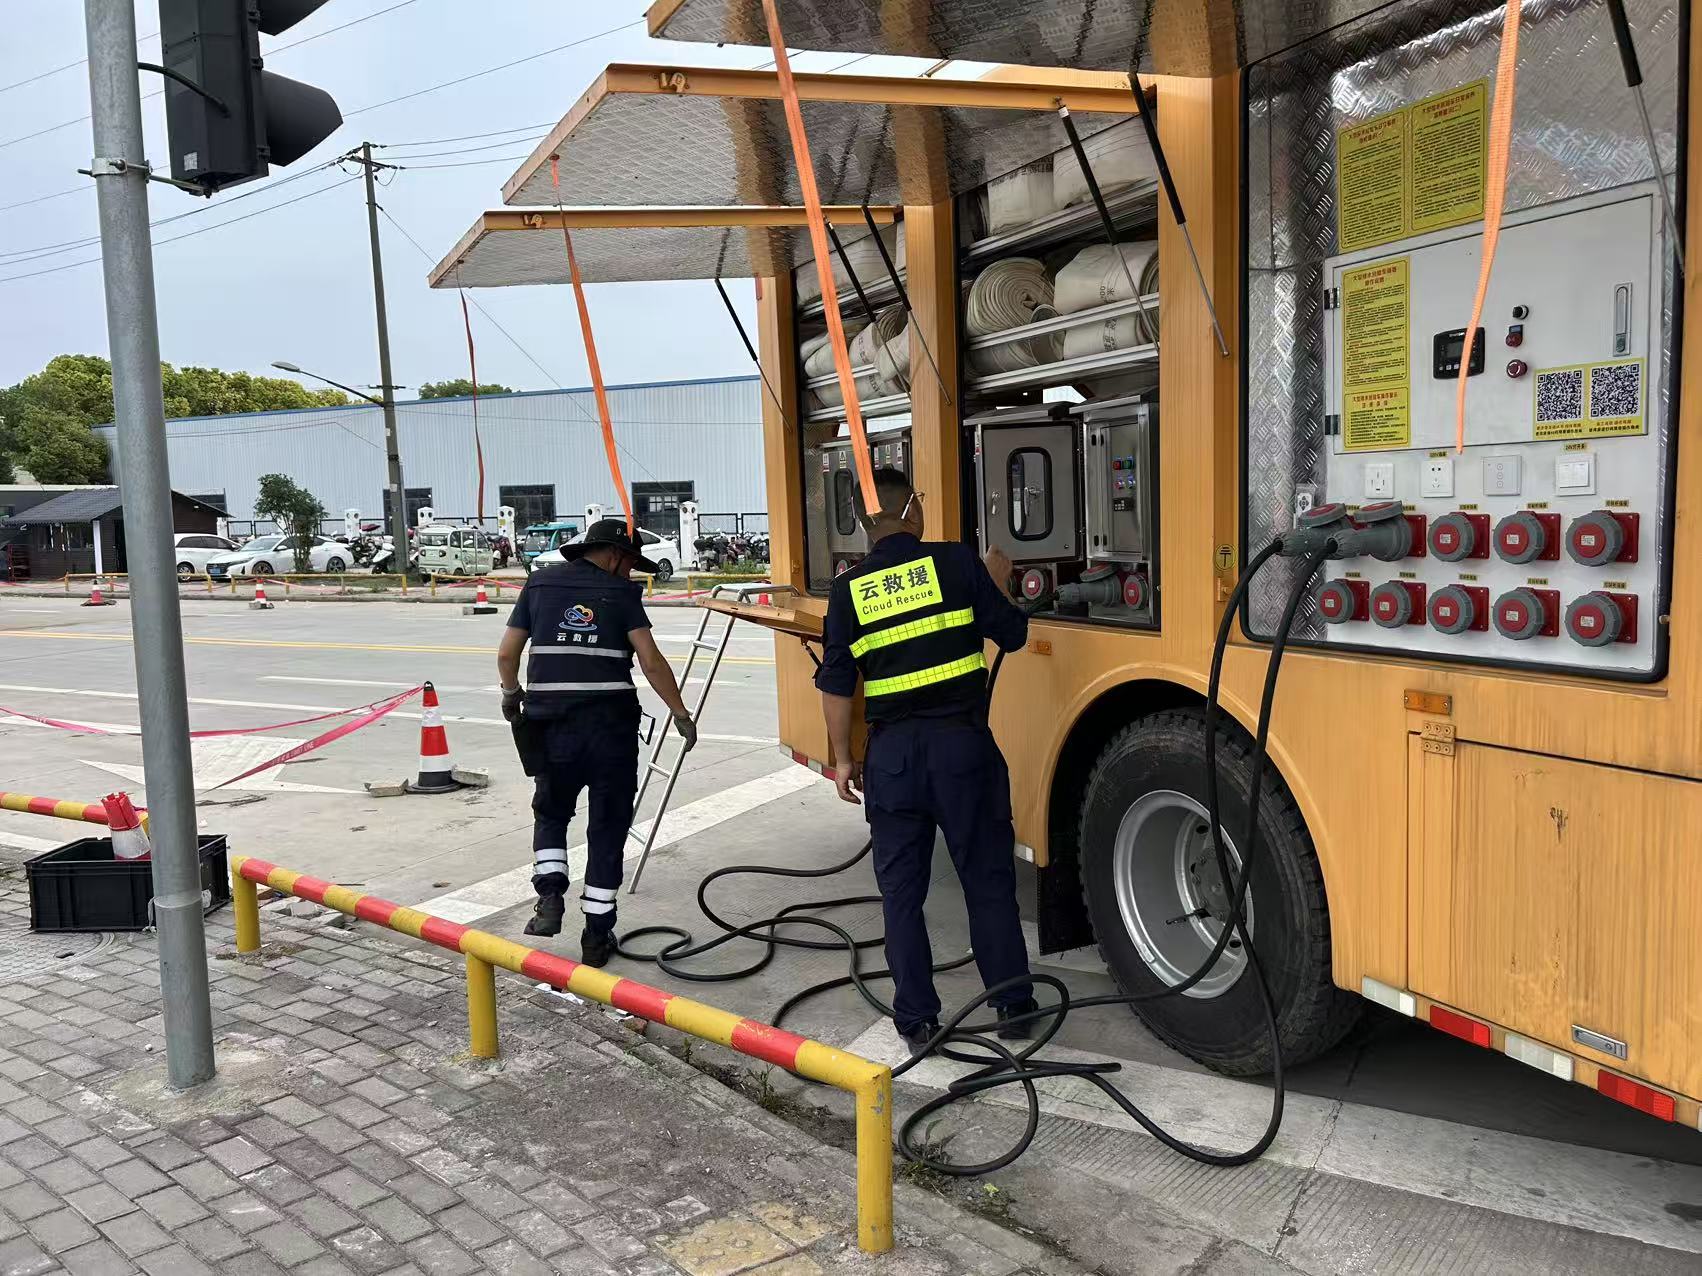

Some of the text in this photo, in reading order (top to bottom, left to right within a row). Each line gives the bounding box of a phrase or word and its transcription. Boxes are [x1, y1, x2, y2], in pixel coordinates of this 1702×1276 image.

[859, 565, 930, 602] 云救援
[862, 589, 934, 615] Cloud Rescue
[556, 632, 599, 644] 云救援
